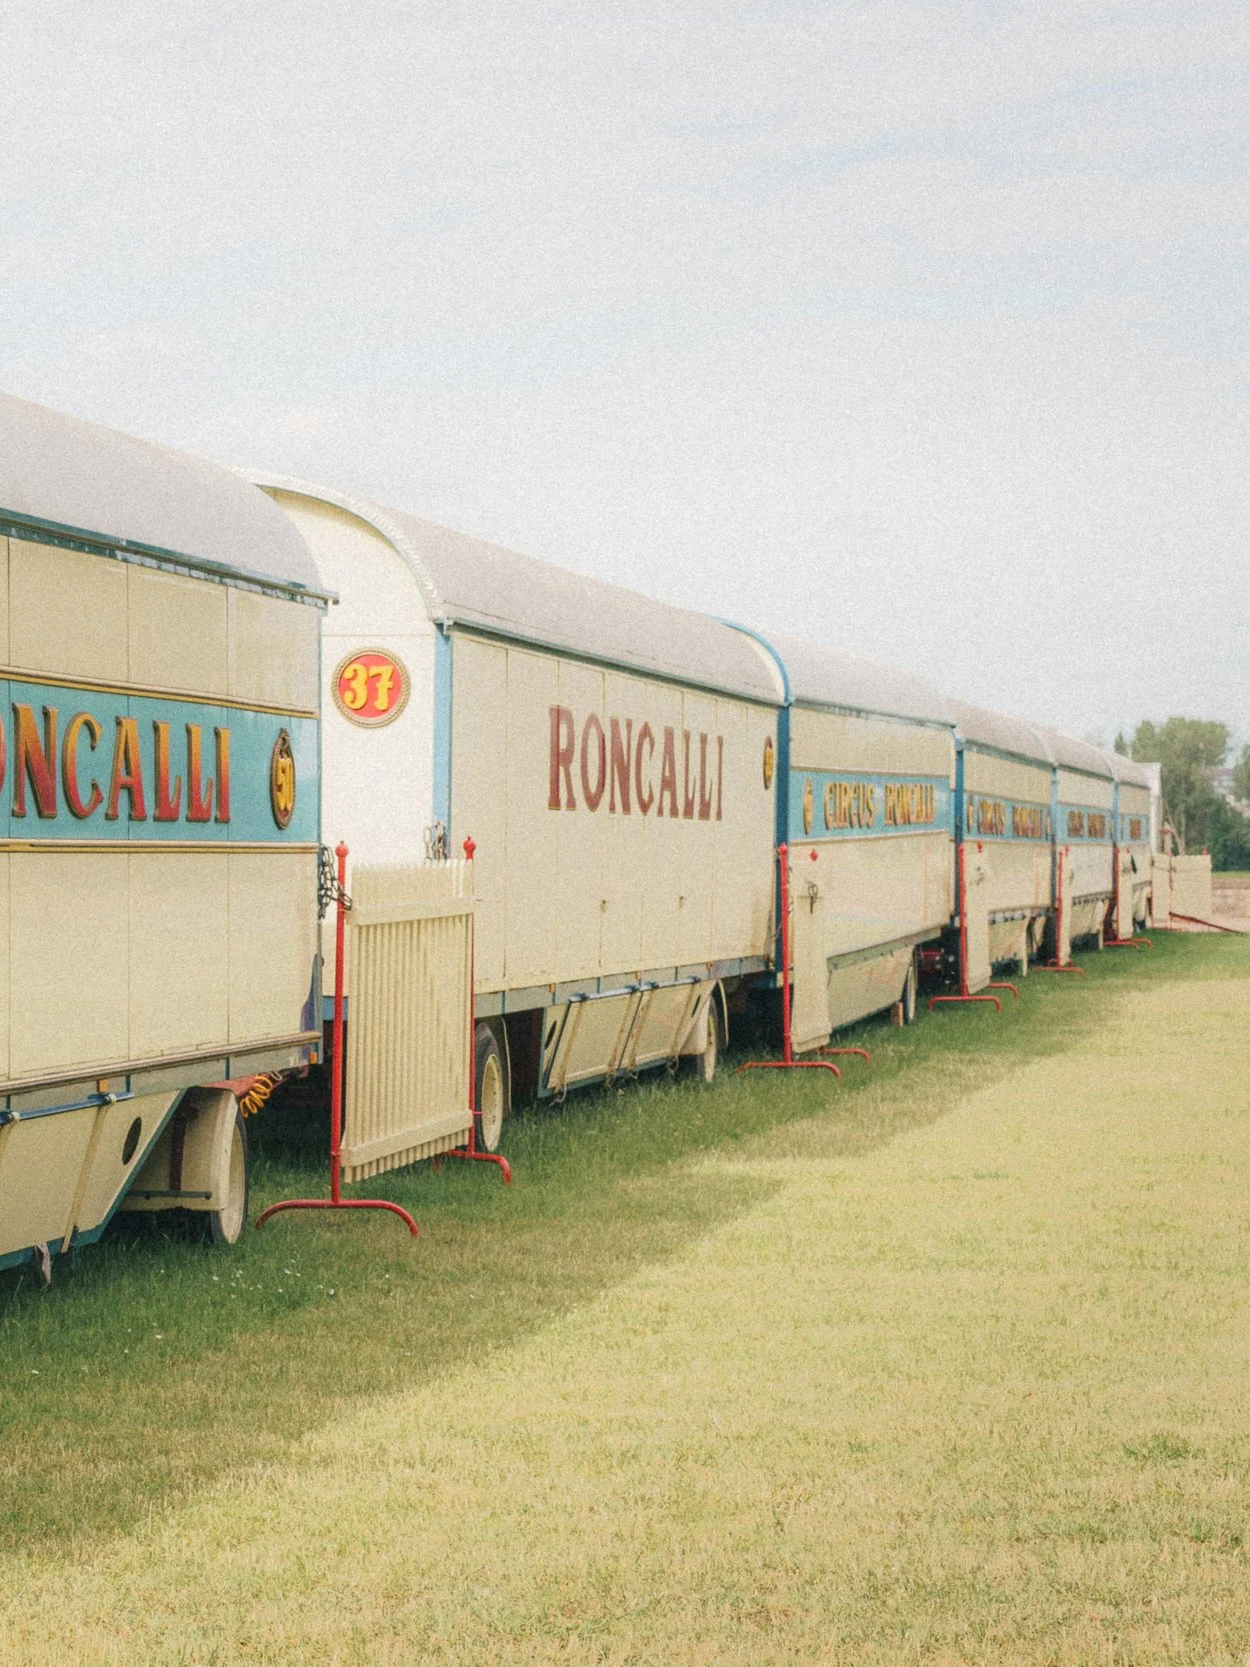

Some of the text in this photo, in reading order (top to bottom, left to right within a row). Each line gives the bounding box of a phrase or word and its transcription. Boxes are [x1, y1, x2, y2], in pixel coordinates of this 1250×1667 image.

[343, 662, 395, 712] 37
[547, 704, 724, 821] RONCALLI
[824, 782, 876, 830] CIRCUS
